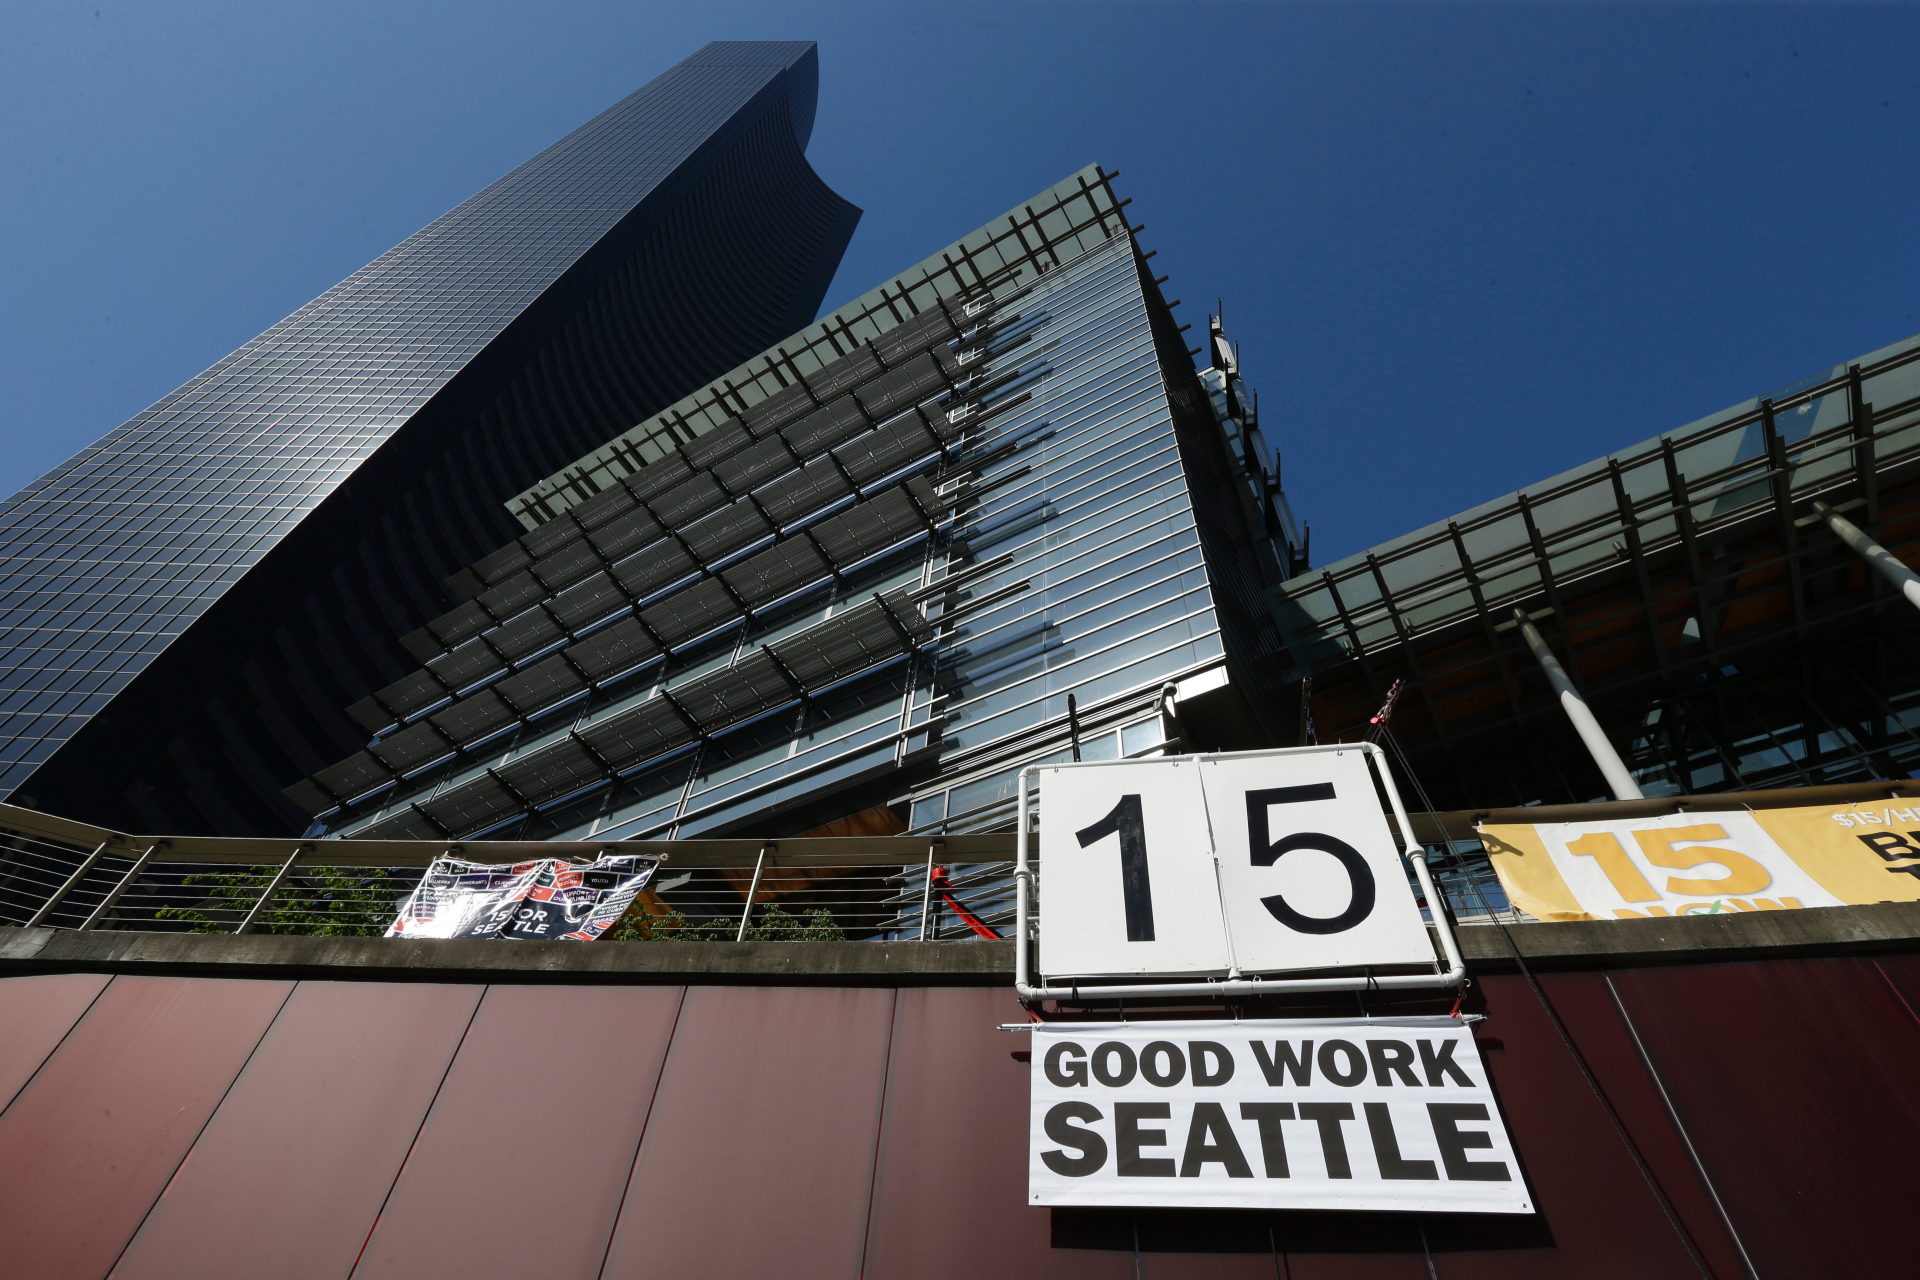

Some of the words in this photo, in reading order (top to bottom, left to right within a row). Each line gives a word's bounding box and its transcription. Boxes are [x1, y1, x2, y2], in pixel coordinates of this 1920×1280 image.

[1831, 807, 1920, 829] $15/H
[1075, 782, 1376, 942] 15
[1565, 823, 1772, 903] 15
[489, 910, 510, 922] 15
[1043, 1040, 1235, 1088] GOOD
[1248, 1039, 1477, 1088] WORK
[1040, 1101, 1512, 1182] SEATTLE
